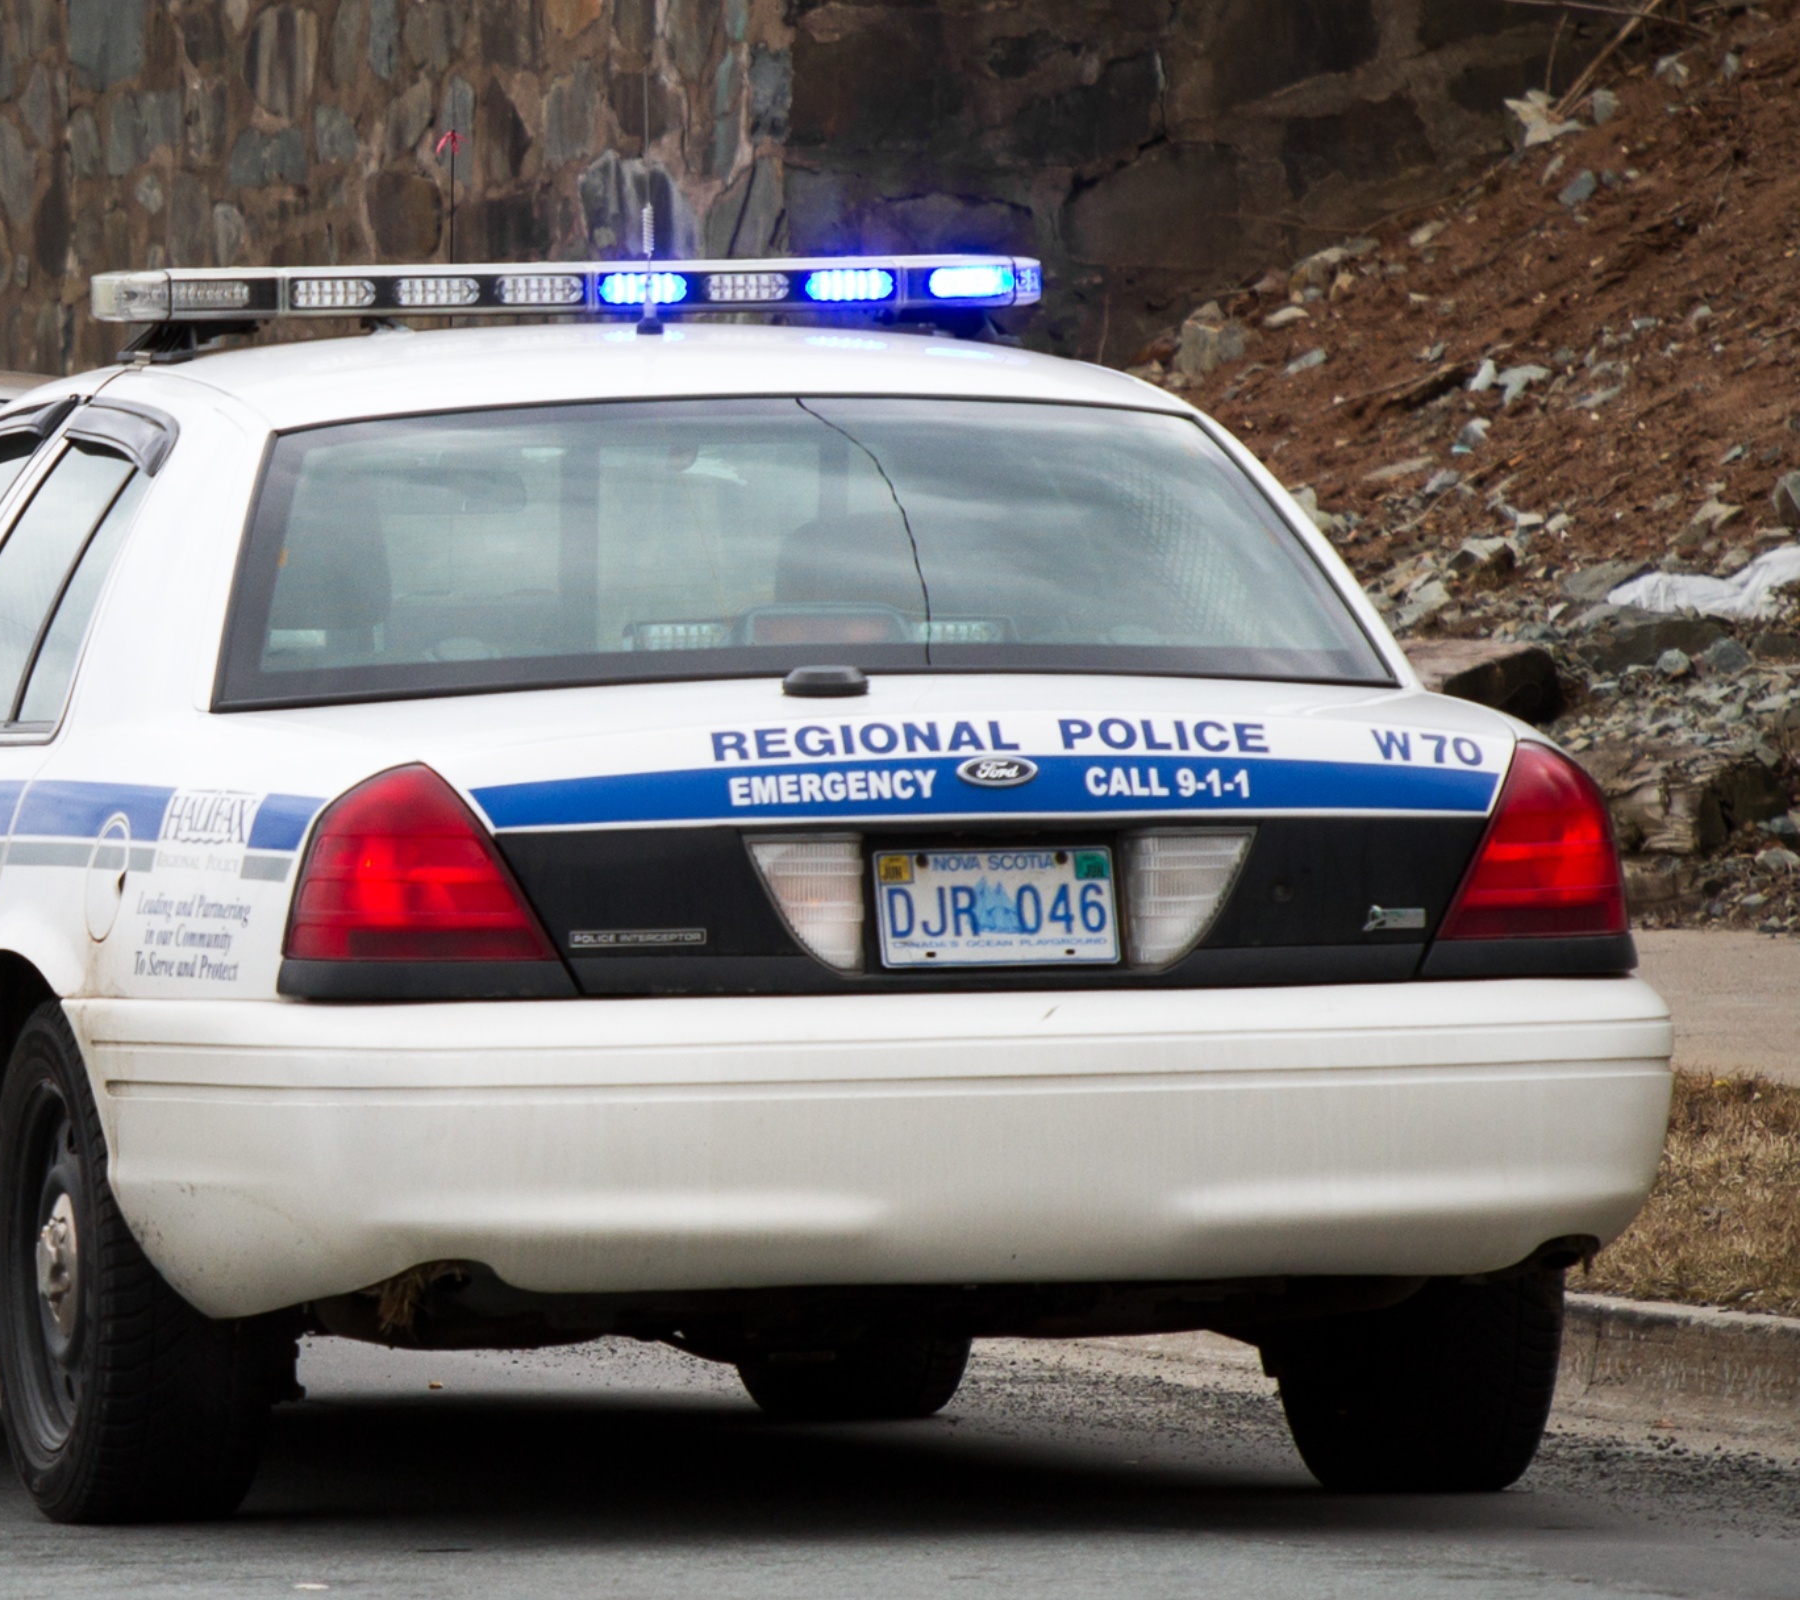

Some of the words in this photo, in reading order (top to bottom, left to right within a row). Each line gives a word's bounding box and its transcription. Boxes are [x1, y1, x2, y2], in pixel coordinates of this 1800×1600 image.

[710, 721, 1020, 762] REGIONAL
[1057, 717, 1271, 754] POLICE
[975, 759, 1019, 779] Ford
[1085, 767, 1170, 797] CALL
[1176, 768, 1250, 798] 9-1-1
[728, 769, 937, 806] EMERGENCY
[161, 796, 260, 843] HALIFAX
[881, 865, 903, 880] JUN
[931, 855, 981, 872] NOVA
[987, 854, 1057, 871] SCOTIA
[136, 891, 175, 923] Leading
[175, 894, 197, 917] and
[195, 895, 251, 929] Partnering
[887, 886, 981, 938] DJR
[1015, 882, 1107, 935] 046
[144, 922, 155, 945] in
[156, 930, 174, 946] our
[175, 923, 233, 957] Community
[574, 934, 616, 943] POLICE
[619, 932, 702, 943] INTERCEPTOR
[966, 938, 1013, 948] OCEAN
[1020, 937, 1107, 947] PLAYGROUND
[134, 951, 146, 976] To
[147, 951, 175, 977] Serve
[176, 954, 198, 978] and
[198, 955, 239, 982] Protect
